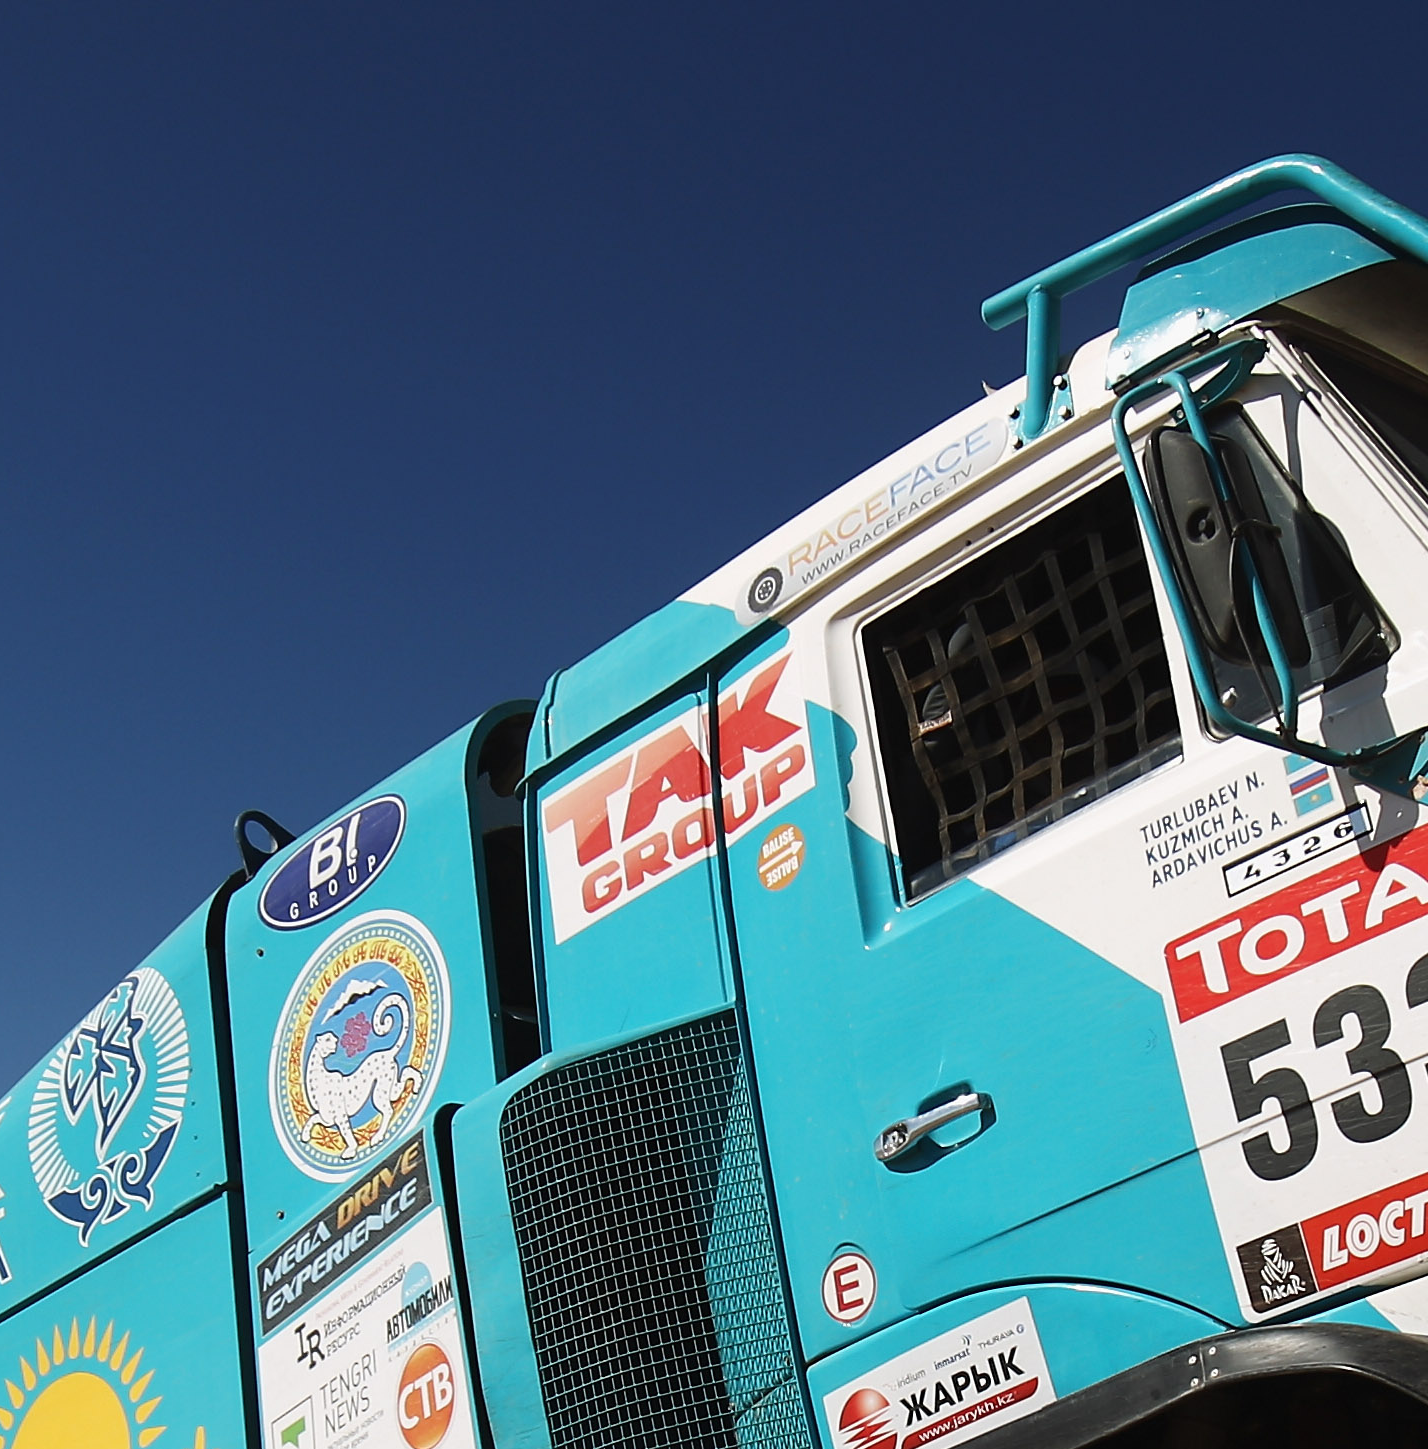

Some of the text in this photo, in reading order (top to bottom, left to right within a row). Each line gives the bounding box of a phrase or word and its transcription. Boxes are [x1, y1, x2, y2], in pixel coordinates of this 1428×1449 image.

[788, 423, 991, 576] RACEFACE
[801, 463, 973, 585] WWW.RACEFACE.TV
[544, 651, 803, 867] TAK
[581, 744, 806, 914] GROUP
[1140, 771, 1265, 845] TURLUBAEV N.
[1146, 804, 1250, 866] KUZMICH A.
[762, 826, 796, 860] BALISE
[766, 855, 799, 888] BALISE
[1151, 811, 1289, 889] ARDAVICHUS A.
[1243, 821, 1355, 880] 4326
[288, 854, 377, 920] GROUP
[262, 1220, 331, 1292] MEGA
[337, 1141, 420, 1230] DRIVE
[265, 1177, 418, 1320] EXPERIENCE
[386, 1275, 454, 1344] АВТОМОБИЛИ
[833, 1263, 864, 1313] E
[1261, 1274, 1304, 1305] DAKAR
[294, 1321, 326, 1370] IR
[933, 1348, 971, 1370] inmarsat
[320, 1349, 377, 1410] TENGRI
[325, 1384, 371, 1438] NEWS
[899, 1346, 1025, 1427] ЖАРЫК
[918, 1392, 1015, 1442] www.jarykh.kz
